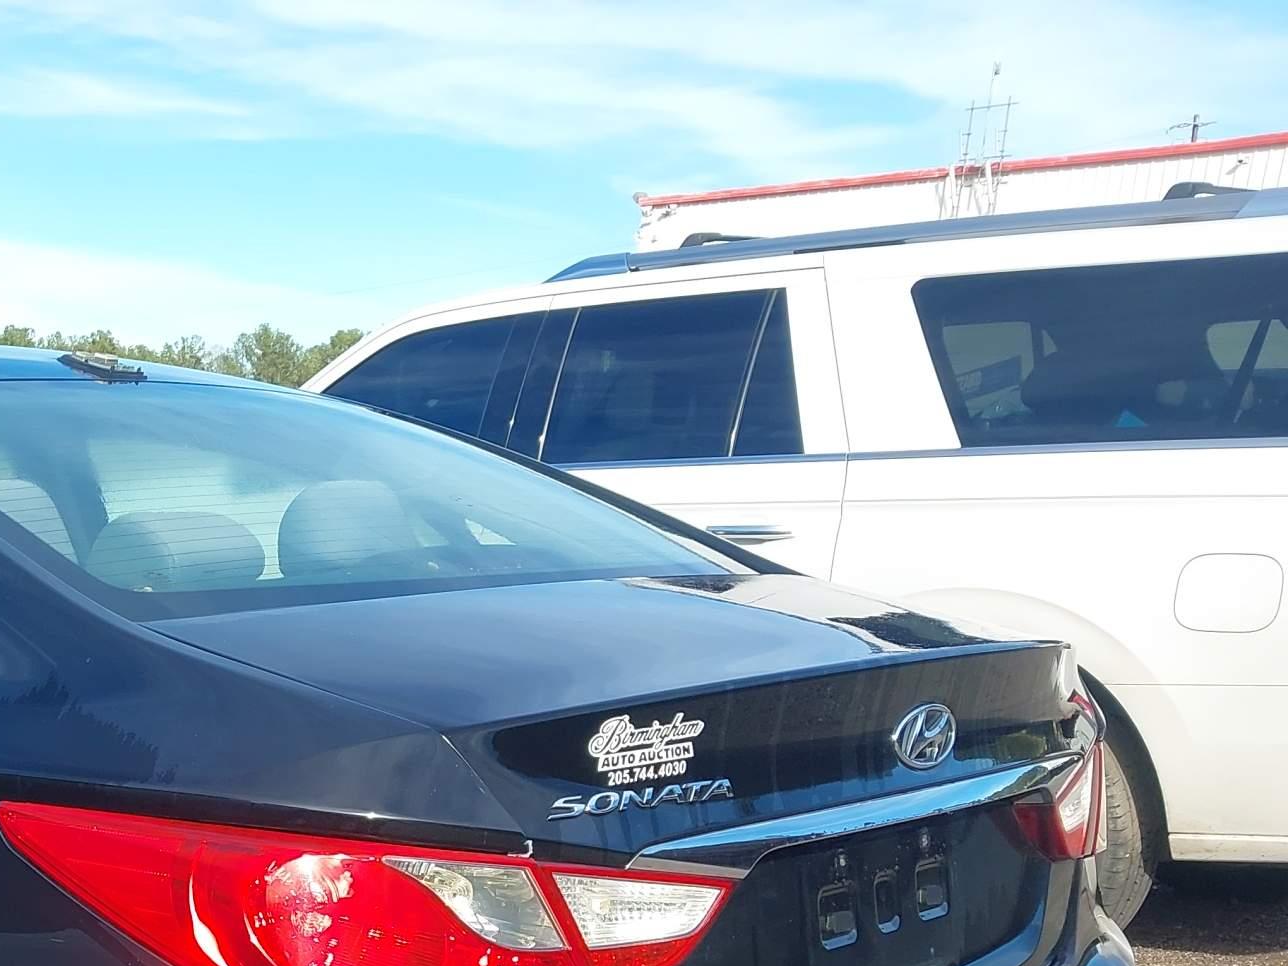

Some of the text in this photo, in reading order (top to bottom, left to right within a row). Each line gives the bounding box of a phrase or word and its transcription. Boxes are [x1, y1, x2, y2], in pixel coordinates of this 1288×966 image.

[590, 714, 703, 755] Birmingham
[601, 744, 691, 769] AUTO AUCTION
[607, 760, 687, 786] 205.744.4030
[546, 779, 734, 821] SONATA
